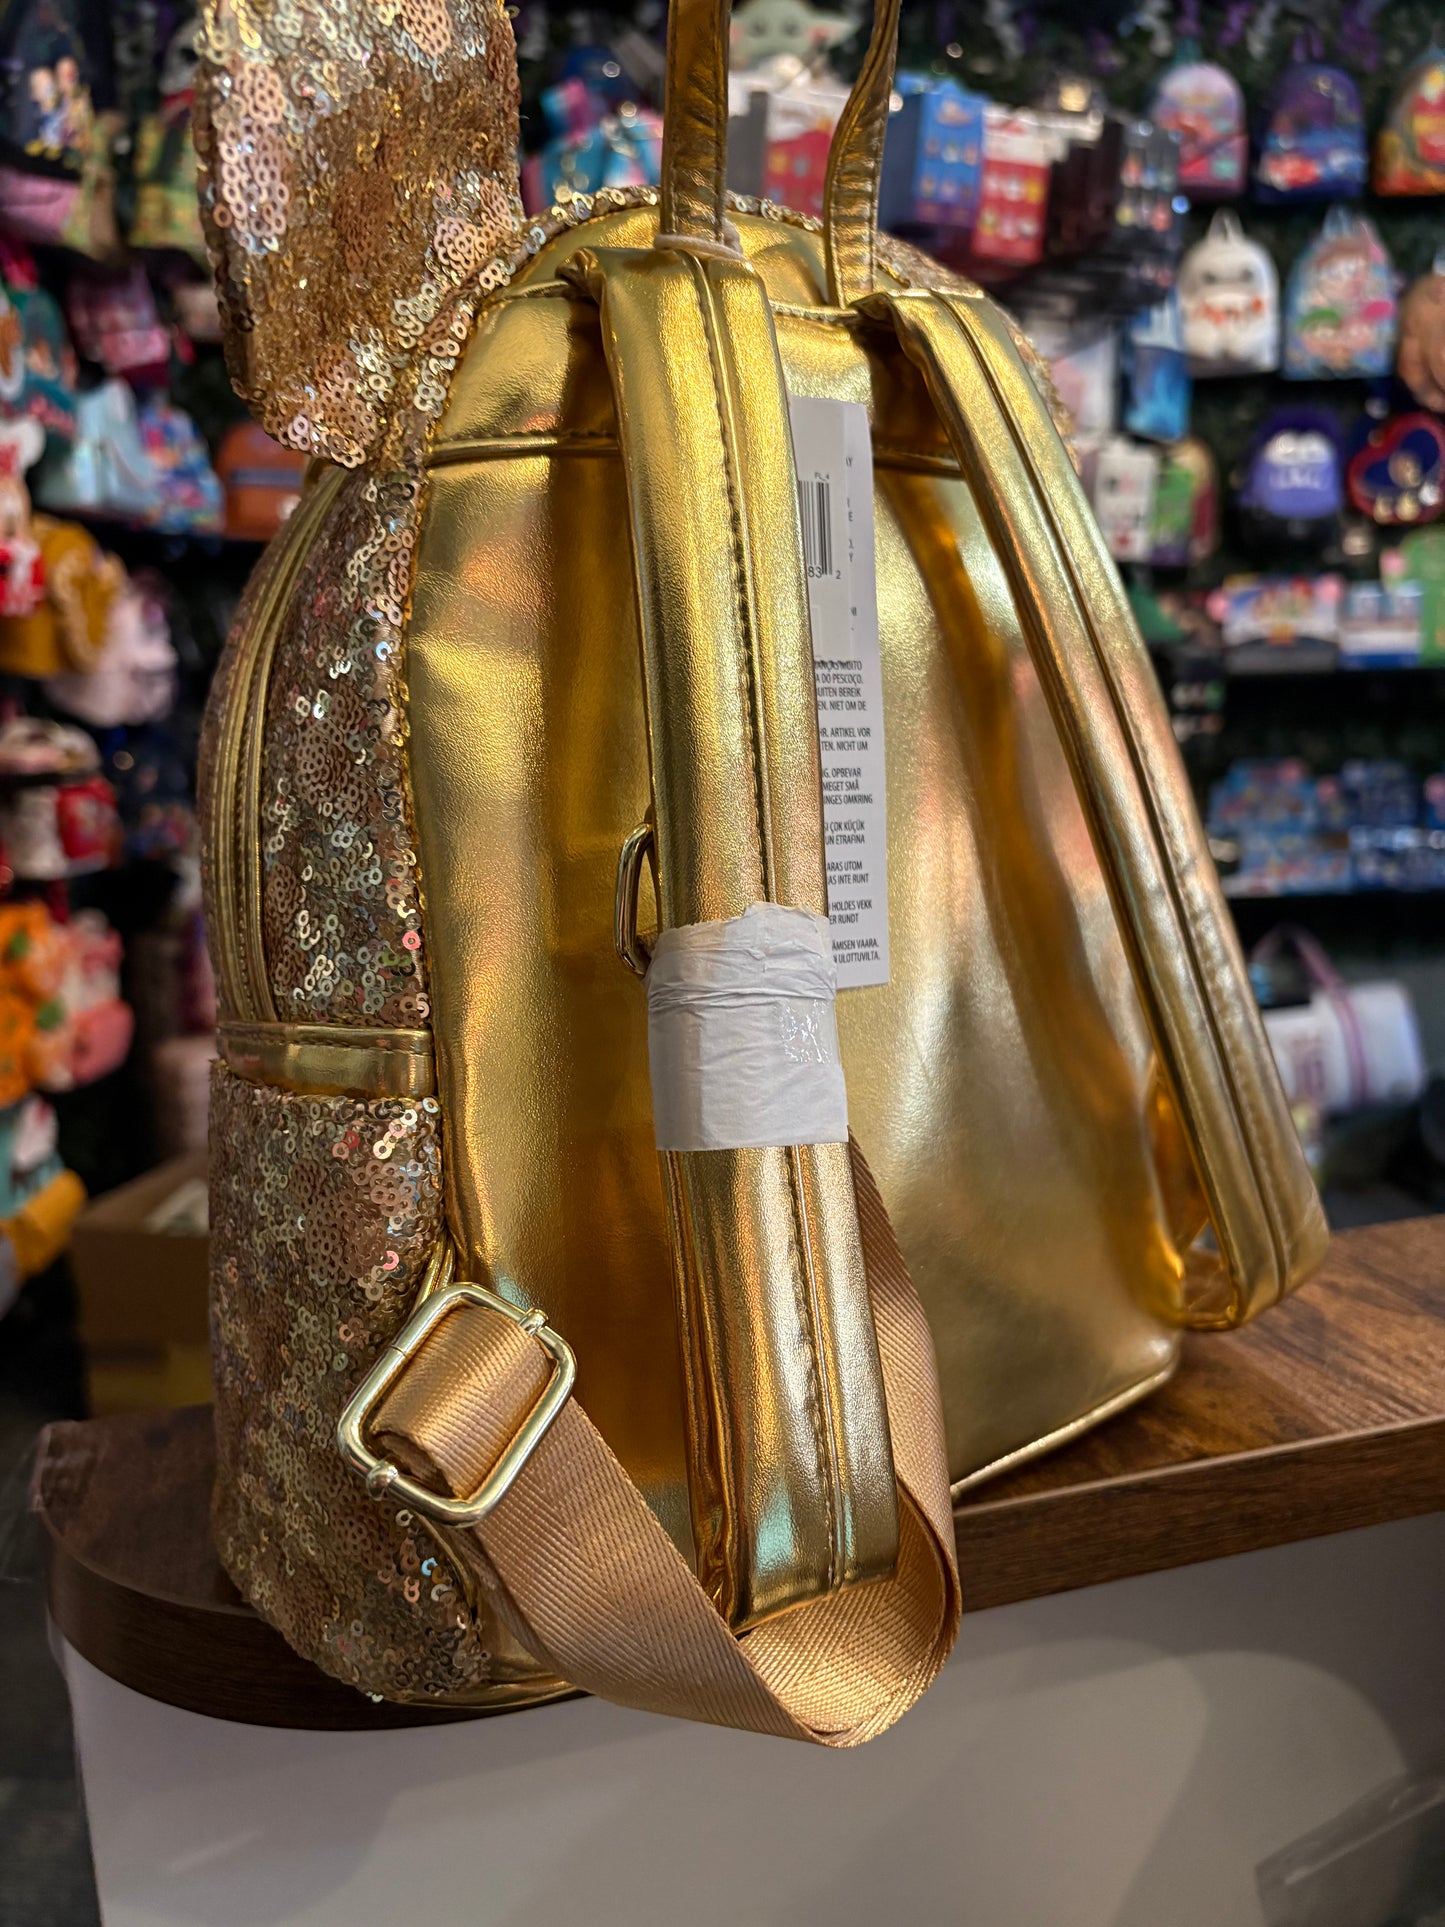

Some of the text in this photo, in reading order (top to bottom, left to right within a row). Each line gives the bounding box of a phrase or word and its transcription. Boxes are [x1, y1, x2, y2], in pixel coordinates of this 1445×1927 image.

[836, 570, 841, 580] 2
[821, 673, 831, 684] DO
[832, 673, 864, 686] PESCOÇO.
[838, 687, 861, 697] BEREIK
[829, 700, 844, 711] NIET
[845, 701, 856, 711] OM
[858, 701, 867, 711] DE
[830, 728, 856, 737] ARTIKEL
[857, 728, 871, 737] VOR
[836, 741, 855, 751] NICHT
[857, 741, 868, 751] UM
[823, 779, 860, 791] MEGET SMÅ
[843, 794, 873, 805] OMKRING
[829, 821, 843, 833] ÇOK
[843, 819, 865, 833] KÜÇÜK
[835, 834, 865, 845] ETRAFINA
[844, 860, 862, 871] UTOM
[837, 874, 852, 884] INTE
[852, 873, 869, 884] RUNT
[831, 900, 856, 911] HOLDES
[856, 899, 873, 910] VEKK
[838, 913, 859, 924] RUNDT
[856, 938, 879, 949] VAARA.
[838, 951, 880, 963] ULOTTUVILTA.
